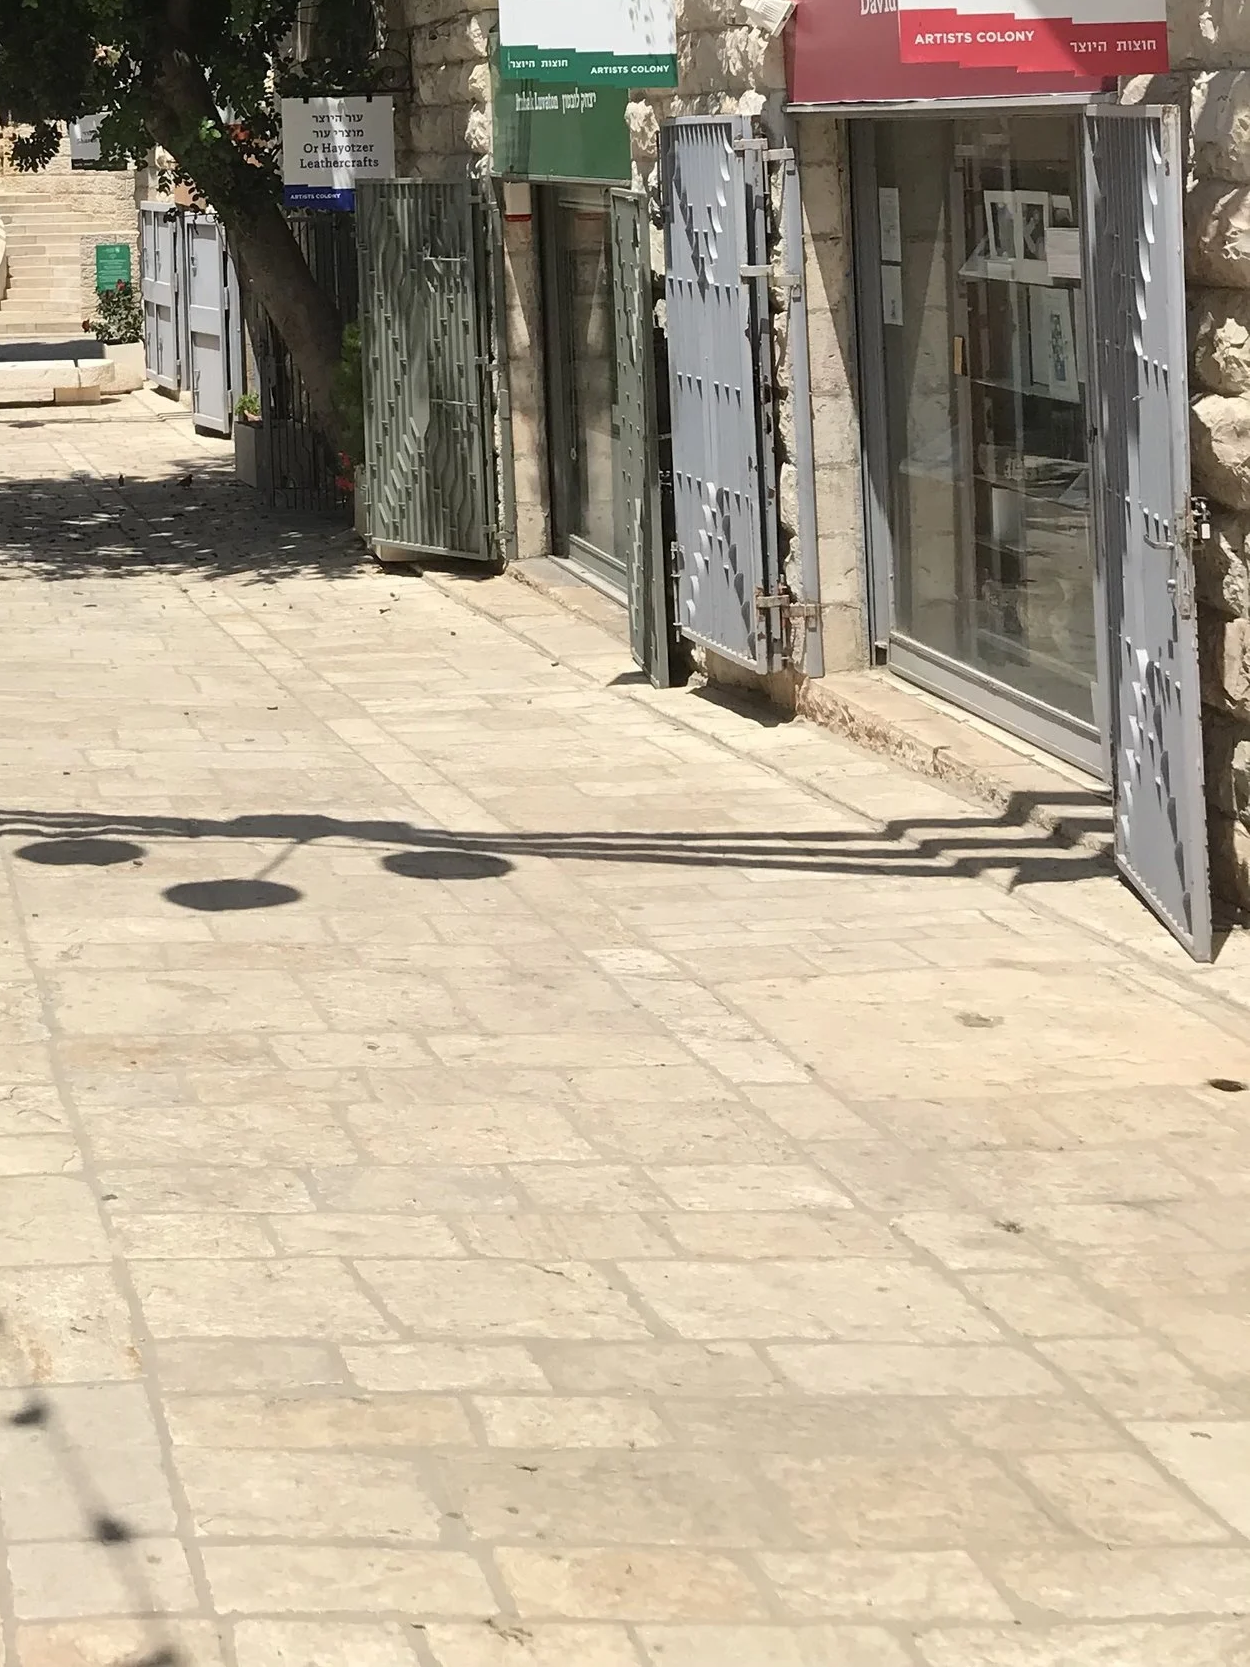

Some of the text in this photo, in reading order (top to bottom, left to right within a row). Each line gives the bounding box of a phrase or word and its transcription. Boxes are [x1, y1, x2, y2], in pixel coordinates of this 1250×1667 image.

[914, 30, 1035, 46] ARTISTS COLONY
[1069, 39, 1157, 53] חוצות היוצר
[541, 59, 568, 68] חוצות
[590, 64, 670, 75] ARTISTS COLONY
[312, 114, 342, 123] היוצר
[312, 129, 364, 138] מוצרי עור
[303, 143, 374, 155] Or Hayotzer
[300, 157, 380, 169] Leathercrafts
